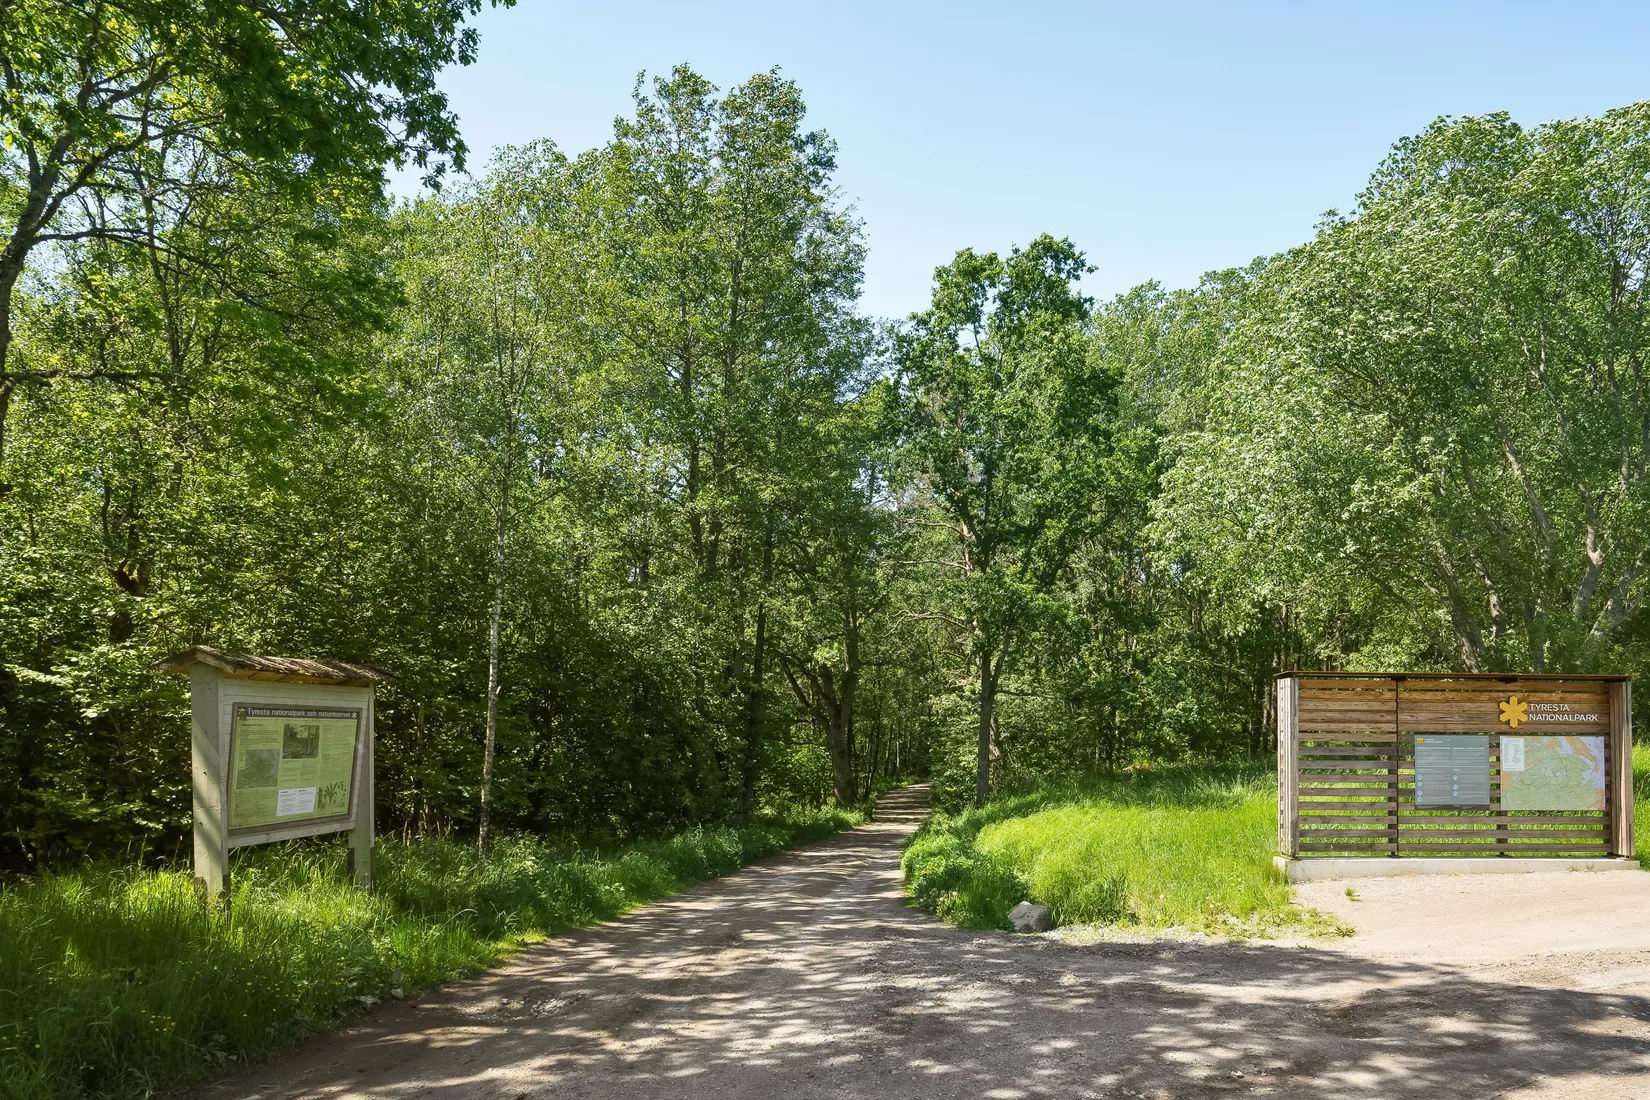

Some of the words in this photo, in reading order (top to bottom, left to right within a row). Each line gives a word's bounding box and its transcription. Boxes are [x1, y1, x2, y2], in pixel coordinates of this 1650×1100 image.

[1529, 703, 1570, 712] TYRESTA
[247, 707, 270, 717] Tyresta
[271, 709, 306, 718] nationalpark
[306, 709, 316, 717] och
[317, 710, 351, 718] naturreservat
[1529, 713, 1598, 722] NATIONALPARK
